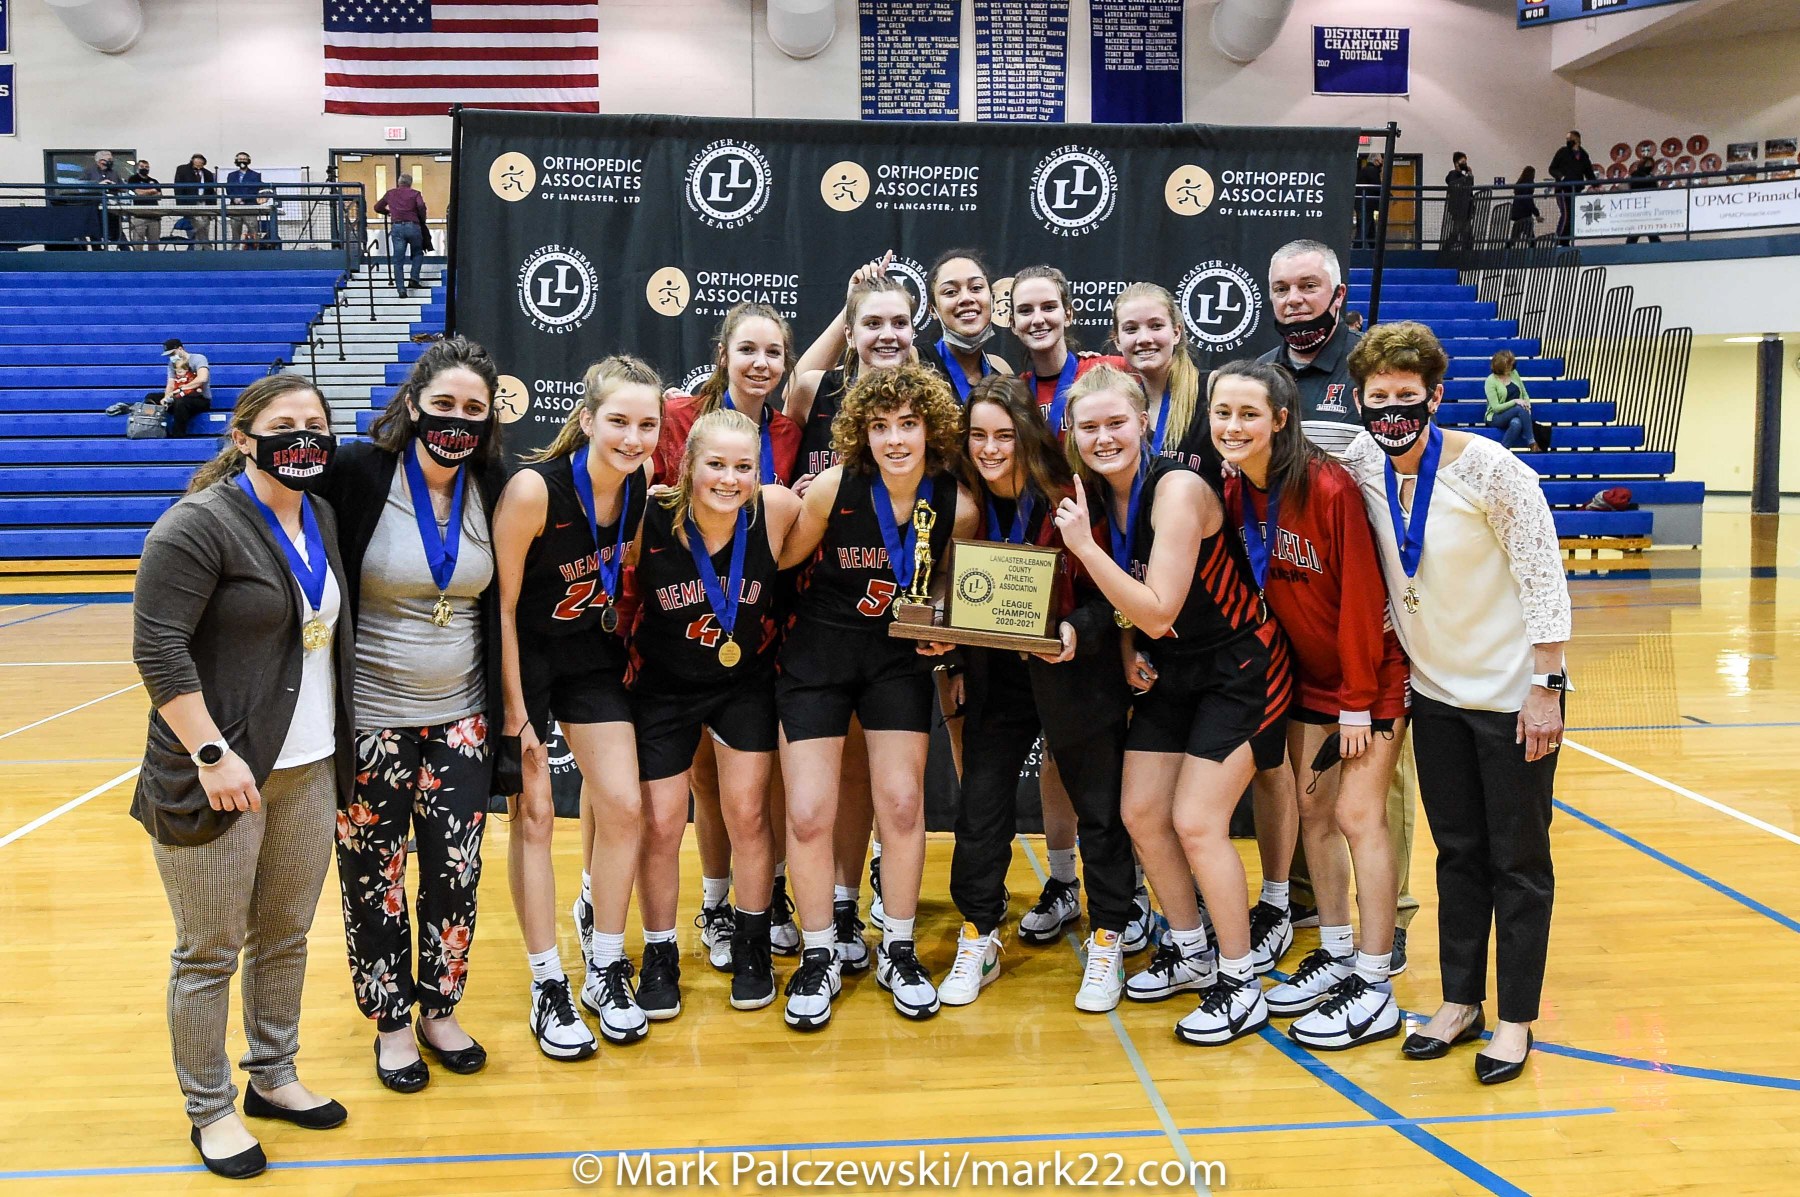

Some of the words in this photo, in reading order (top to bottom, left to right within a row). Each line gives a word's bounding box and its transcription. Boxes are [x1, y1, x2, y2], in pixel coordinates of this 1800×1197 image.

[1324, 29, 1382, 39] DISTRICT
[1386, 30, 1399, 40] III
[1324, 39, 1398, 50] CHAMPIONS
[1340, 50, 1383, 61] FOOTBALL
[388, 128, 402, 138] EXIT
[543, 156, 642, 173] ORTHOPEDIC
[685, 138, 735, 185] LANCASTER
[740, 140, 773, 188] LEBANON
[1029, 145, 1078, 190] LANCASTER
[1087, 146, 1118, 192] LEBANON
[877, 165, 979, 180] ORTHOPEDIC
[1221, 170, 1325, 186] ORTHOPEDIC
[541, 173, 641, 189] ASSOCIATES
[875, 182, 978, 197] ASSOCIATES
[1219, 188, 1324, 203] ASSOCIATES
[558, 193, 617, 203] LANCASTER,
[624, 196, 641, 204] LTD
[1610, 196, 1651, 210] MTEF
[1695, 192, 1743, 207] UPMC
[1748, 188, 1800, 203] Pinnacl
[893, 203, 954, 212] LANCASTER,
[1237, 209, 1301, 217] LANCASTER,
[698, 213, 754, 230] LEAGUE
[1044, 221, 1100, 237] LEAGUE
[517, 244, 560, 287] LANCASTER
[568, 247, 599, 292] LEBANON
[697, 271, 799, 288] ORTHOPEDIC
[1231, 264, 1262, 309] LEBANON
[694, 289, 798, 305] ASSOCIATES
[531, 318, 582, 334] LEAGUE
[1189, 336, 1244, 352] LEAGUE
[534, 379, 585, 395] ORTHO
[1323, 384, 1345, 405] H
[534, 415, 546, 423] OF
[273, 448, 328, 466] HEMPFIELD
[990, 555, 1052, 567] LANCASTER-LEBANON
[1008, 565, 1032, 574] COUNTY
[1004, 575, 1034, 583] ATHLETIC
[999, 583, 1037, 592] ASSOCIATION
[856, 579, 897, 617] 5
[1001, 600, 1032, 610] LEAGUE
[992, 608, 1040, 619] CHAMPION
[686, 613, 722, 648] 4
[996, 618, 1034, 628] 2020-2021
